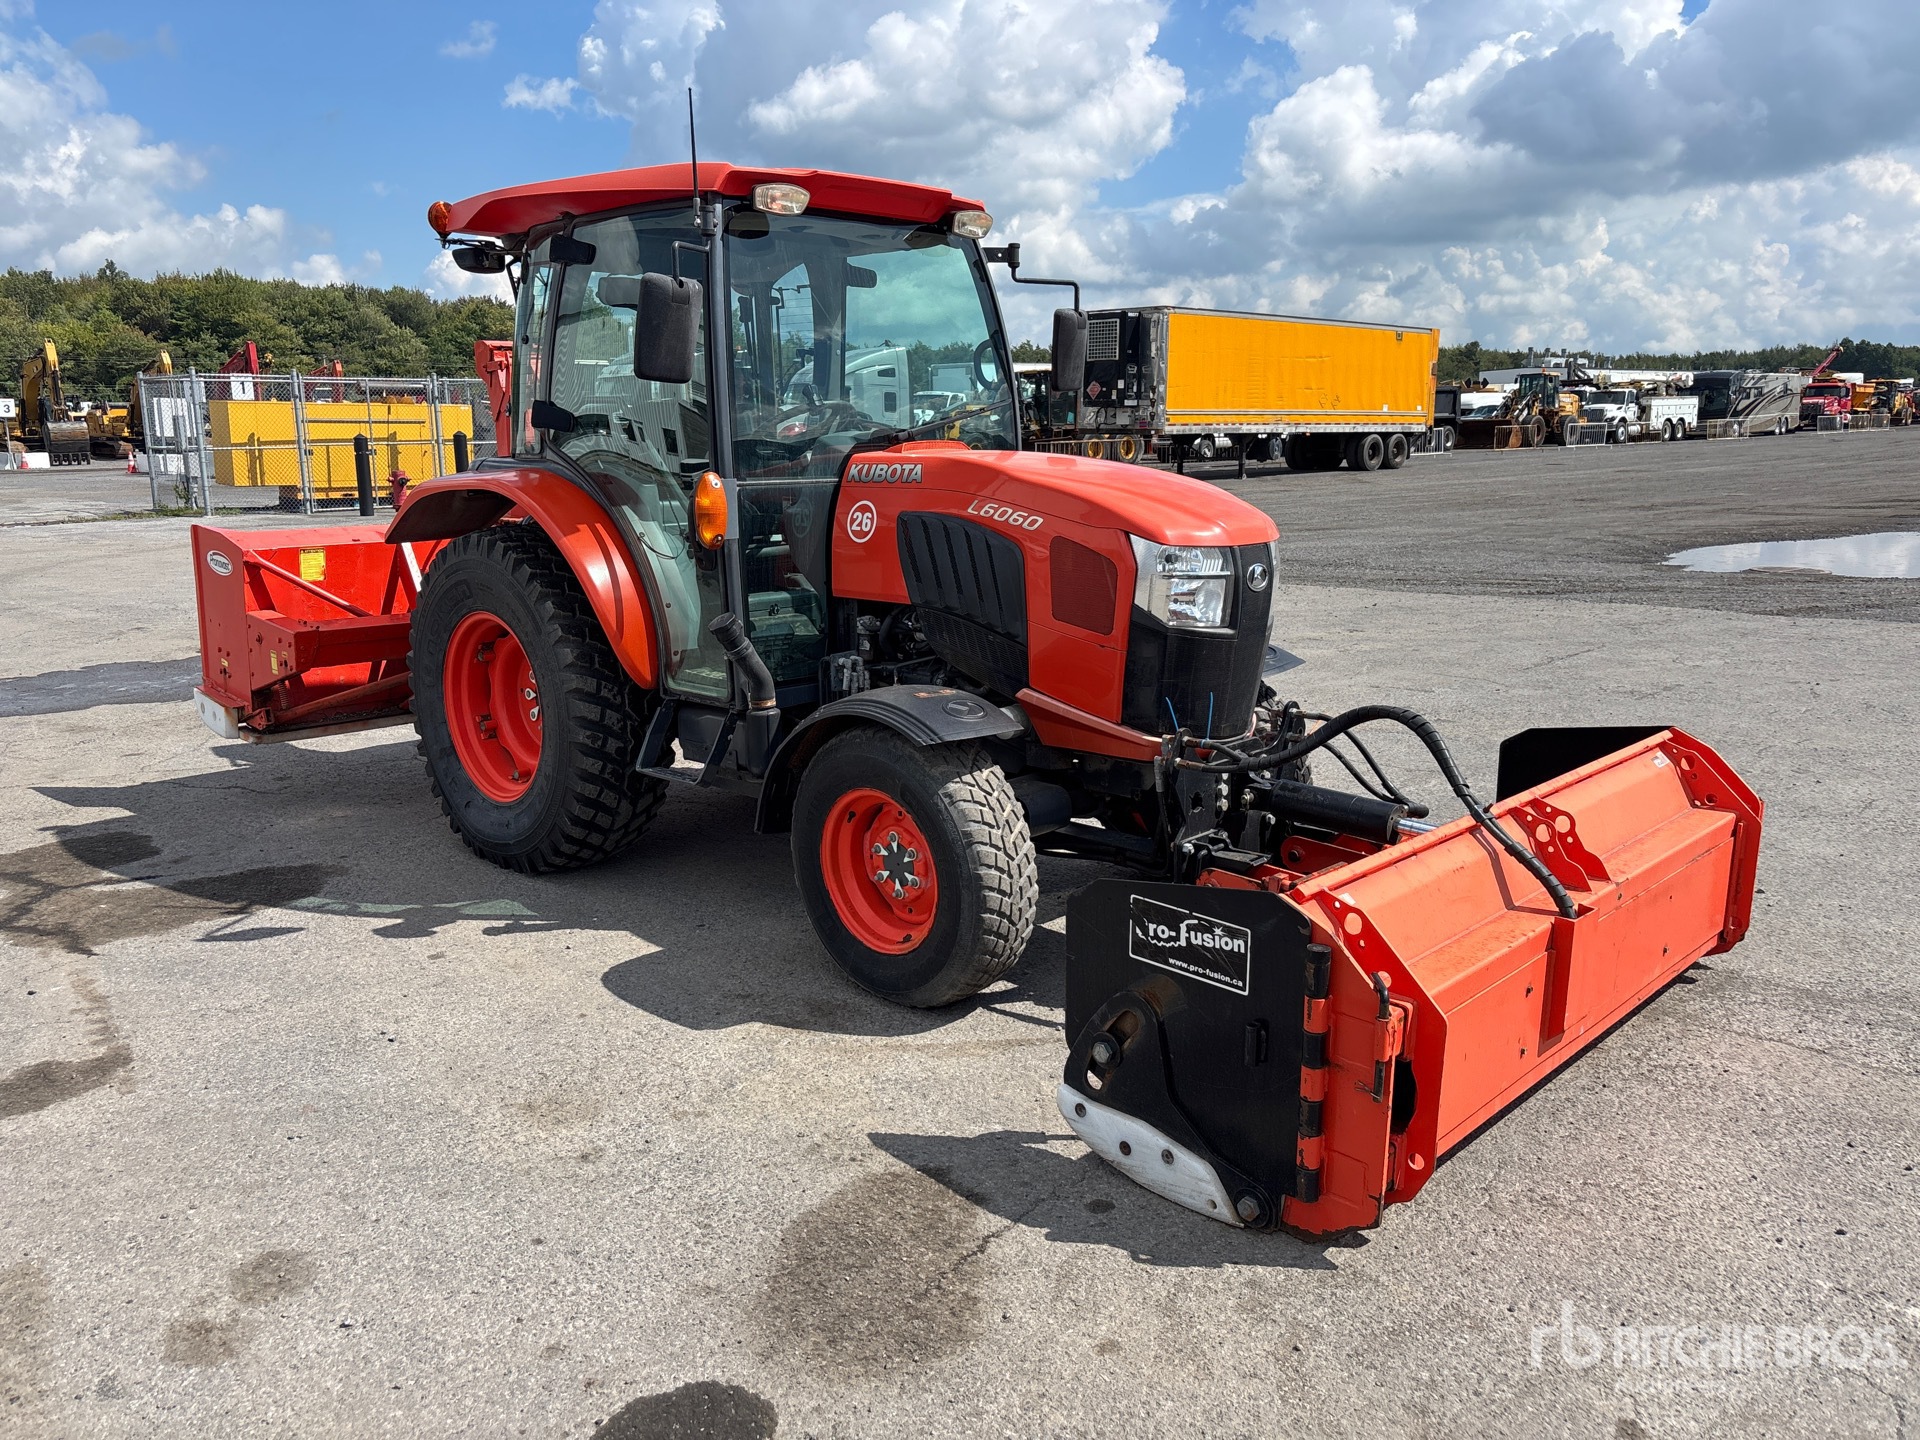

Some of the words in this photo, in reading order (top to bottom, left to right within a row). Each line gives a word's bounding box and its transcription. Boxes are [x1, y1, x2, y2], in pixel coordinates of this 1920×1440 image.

[239, 381, 246, 394] 1
[3, 404, 10, 413] 3
[847, 463, 922, 483] KUBOTA
[851, 512, 872, 531] 26
[967, 499, 1044, 530] L6060
[1136, 919, 1246, 953] ro-fusion
[1168, 957, 1243, 987] www.pro-fusion.ca
